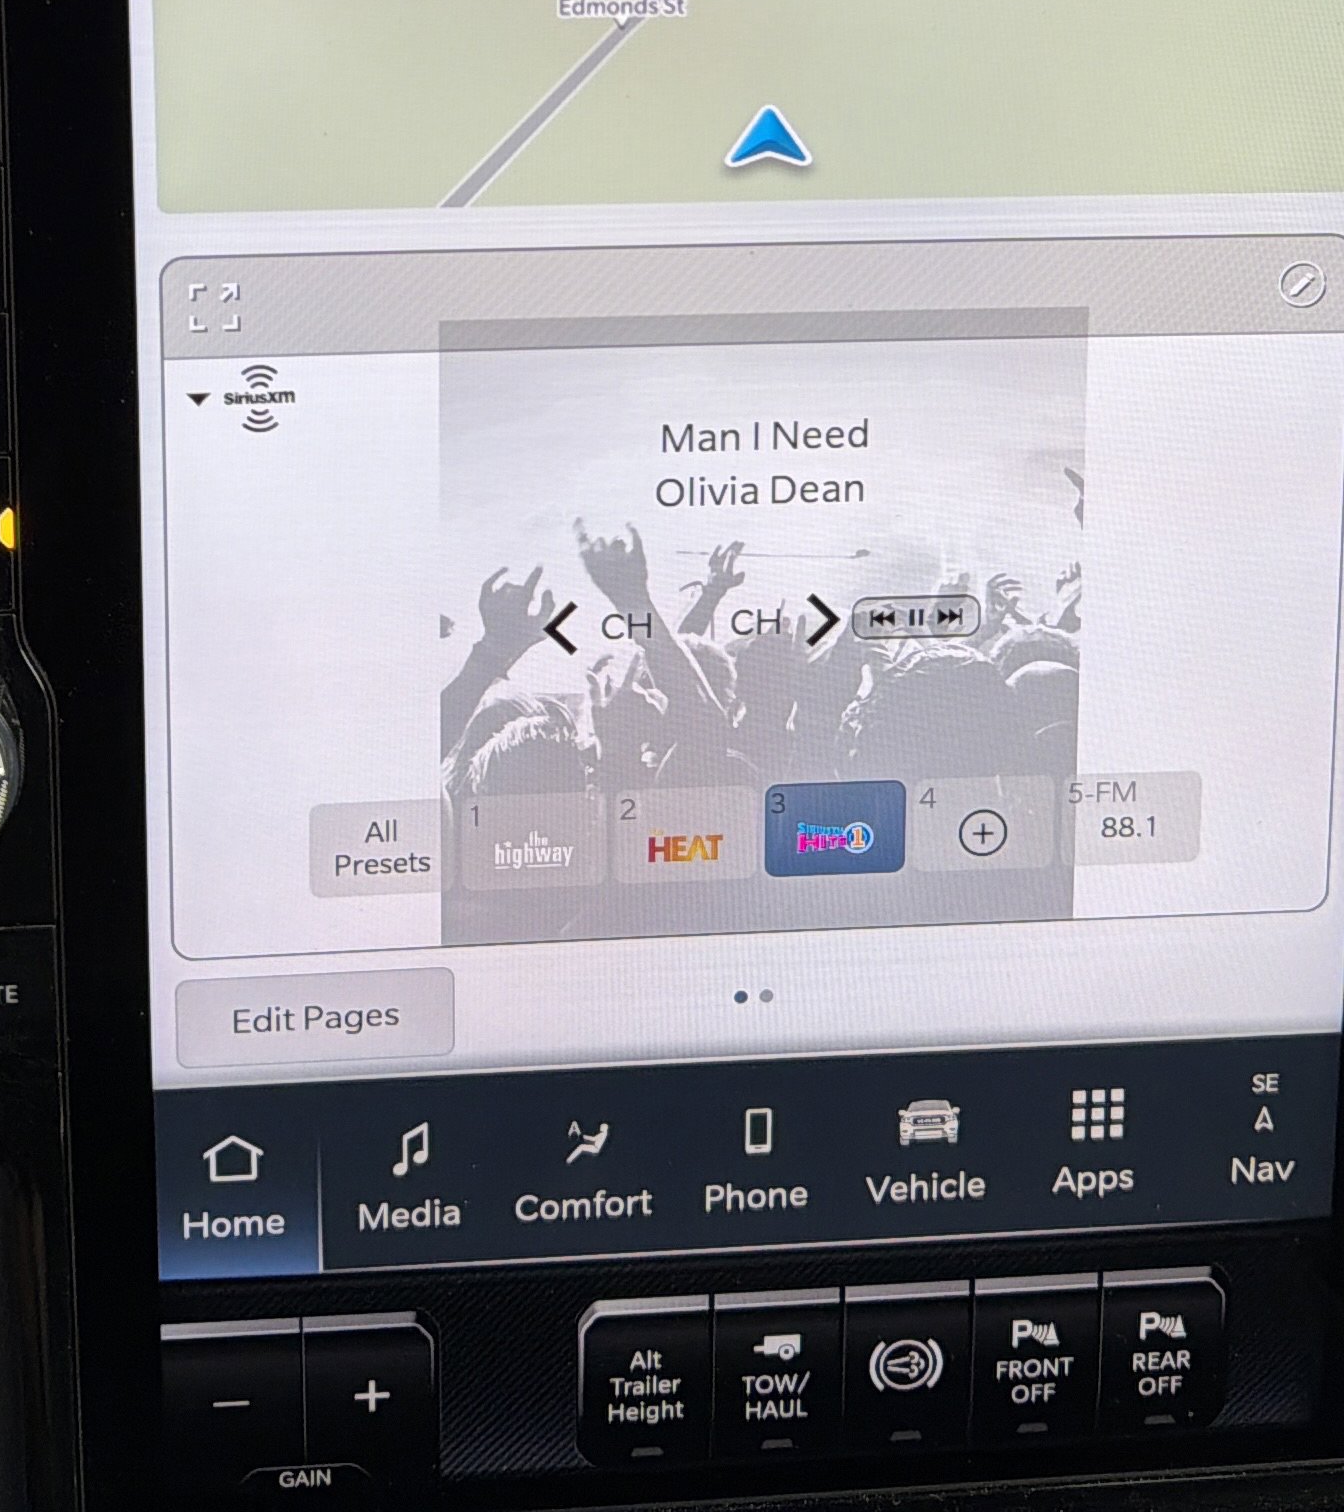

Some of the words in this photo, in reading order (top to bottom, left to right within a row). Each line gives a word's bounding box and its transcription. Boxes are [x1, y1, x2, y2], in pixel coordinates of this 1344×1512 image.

[662, 423, 740, 454] Man
[753, 421, 760, 451] I
[772, 417, 869, 450] Need
[655, 475, 759, 507] Olivia
[771, 475, 864, 505] Dean
[601, 612, 653, 640] CH
[731, 608, 782, 636] CH
[770, 792, 786, 815] 3
[918, 787, 937, 809] 4
[1067, 780, 1138, 805] 5-FM
[470, 804, 479, 828] 1
[619, 798, 637, 821] 2
[364, 818, 398, 844] All
[1101, 815, 1155, 838] 88.1
[494, 841, 575, 870] highway
[647, 834, 724, 863] HEAT
[335, 852, 431, 877] Presets
[233, 1006, 296, 1034] Edit
[304, 1005, 400, 1035] Pages
[1251, 1073, 1279, 1094] SE
[1051, 1166, 1134, 1199] Apps
[1231, 1156, 1295, 1185] Nav
[705, 1182, 809, 1213] Phone
[865, 1170, 986, 1203] Vehicle
[358, 1198, 461, 1231] Media
[515, 1189, 653, 1222] Comfort
[183, 1211, 285, 1240] Home
[629, 1349, 662, 1371] Alt
[996, 1356, 1074, 1381] FRONT
[1132, 1349, 1191, 1373] REAR
[609, 1374, 682, 1398] Trailer
[741, 1370, 811, 1396] TOW/
[1011, 1382, 1056, 1404] OFF
[1138, 1375, 1183, 1396] OFF
[607, 1399, 685, 1424] Height
[745, 1398, 808, 1421] HAUL
[278, 1468, 332, 1488] GAIN
